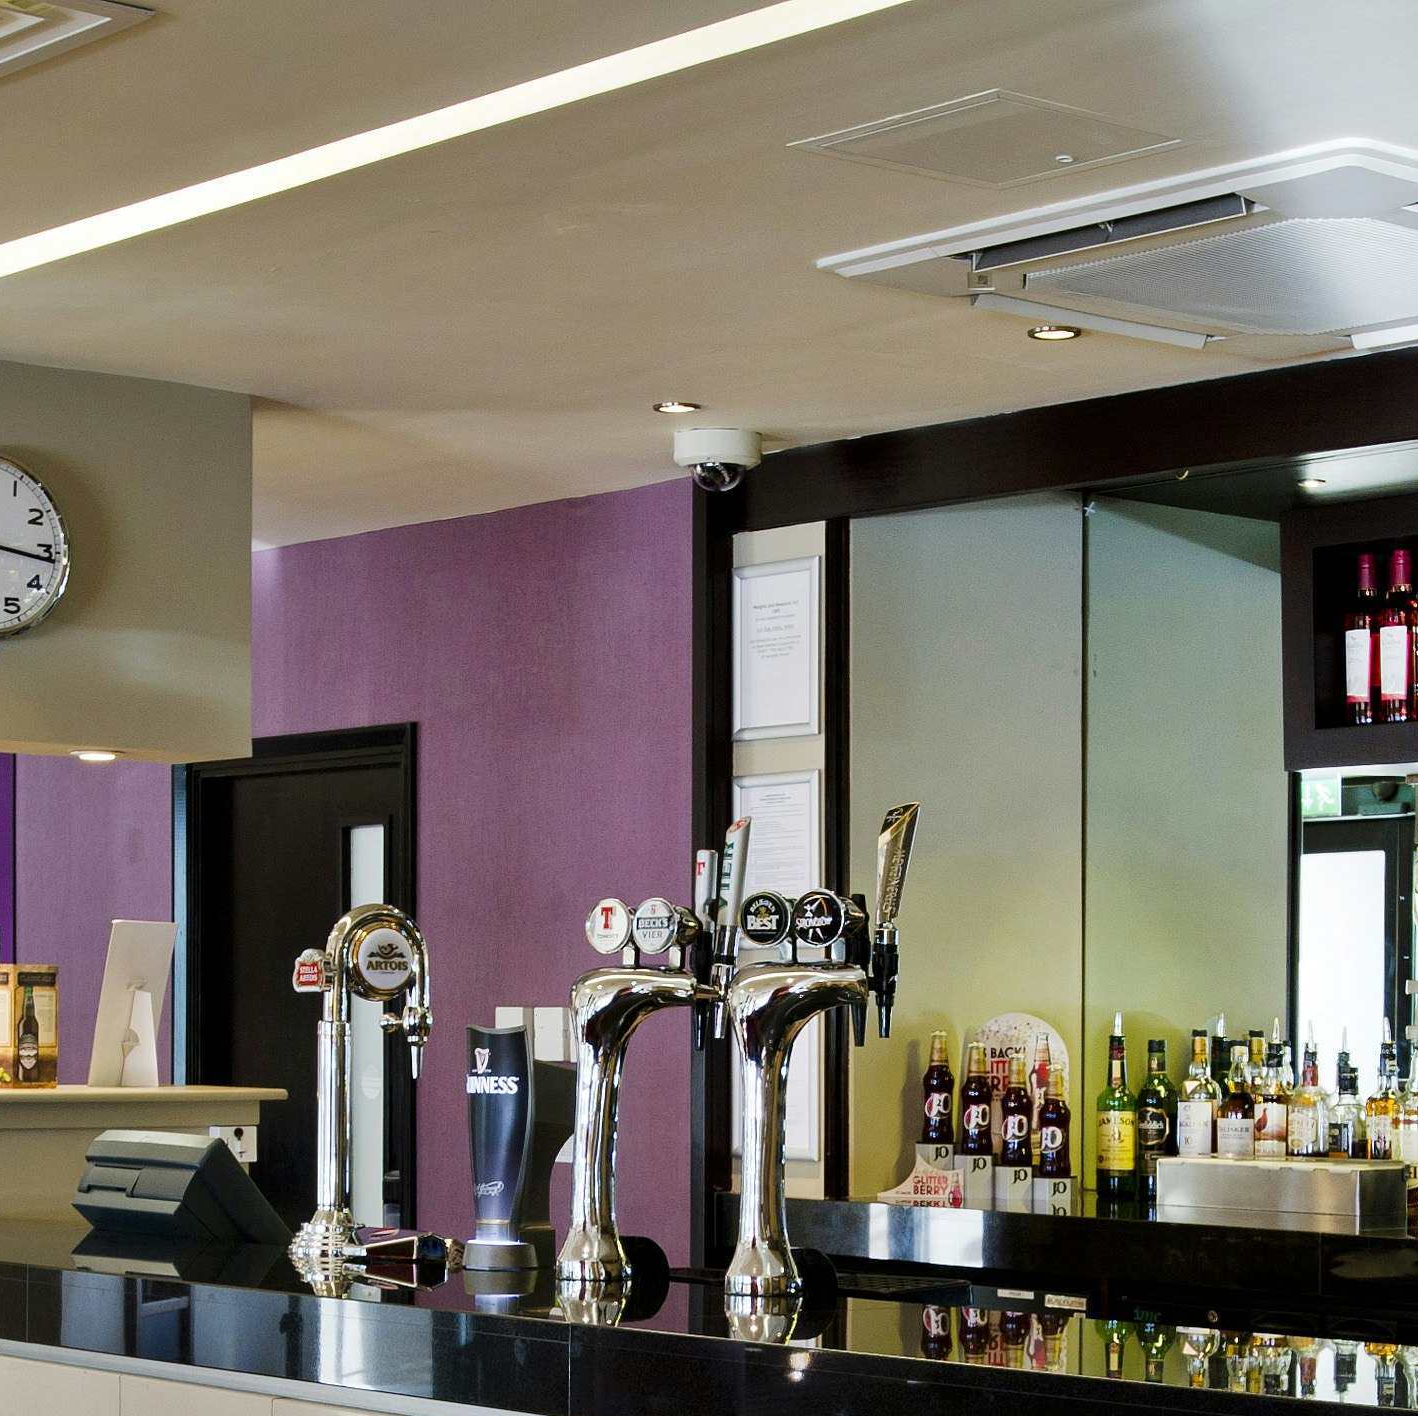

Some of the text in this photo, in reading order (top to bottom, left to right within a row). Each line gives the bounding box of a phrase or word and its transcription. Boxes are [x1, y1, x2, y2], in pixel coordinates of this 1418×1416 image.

[13, 481, 17, 497] 1
[28, 508, 44, 526] 2
[37, 544, 53, 561] 3
[27, 574, 42, 590] 4
[3, 597, 20, 614] 5
[601, 907, 614, 929] T
[638, 917, 668, 928] BECK'S
[747, 915, 779, 930] BEST
[643, 931, 662, 939] VIER
[299, 966, 318, 974] STELLA
[366, 959, 409, 972] ARTOIS
[299, 974, 318, 983] ARTOIS
[913, 1175, 948, 1185] GLITTER
[913, 1185, 948, 1195] BERRY
